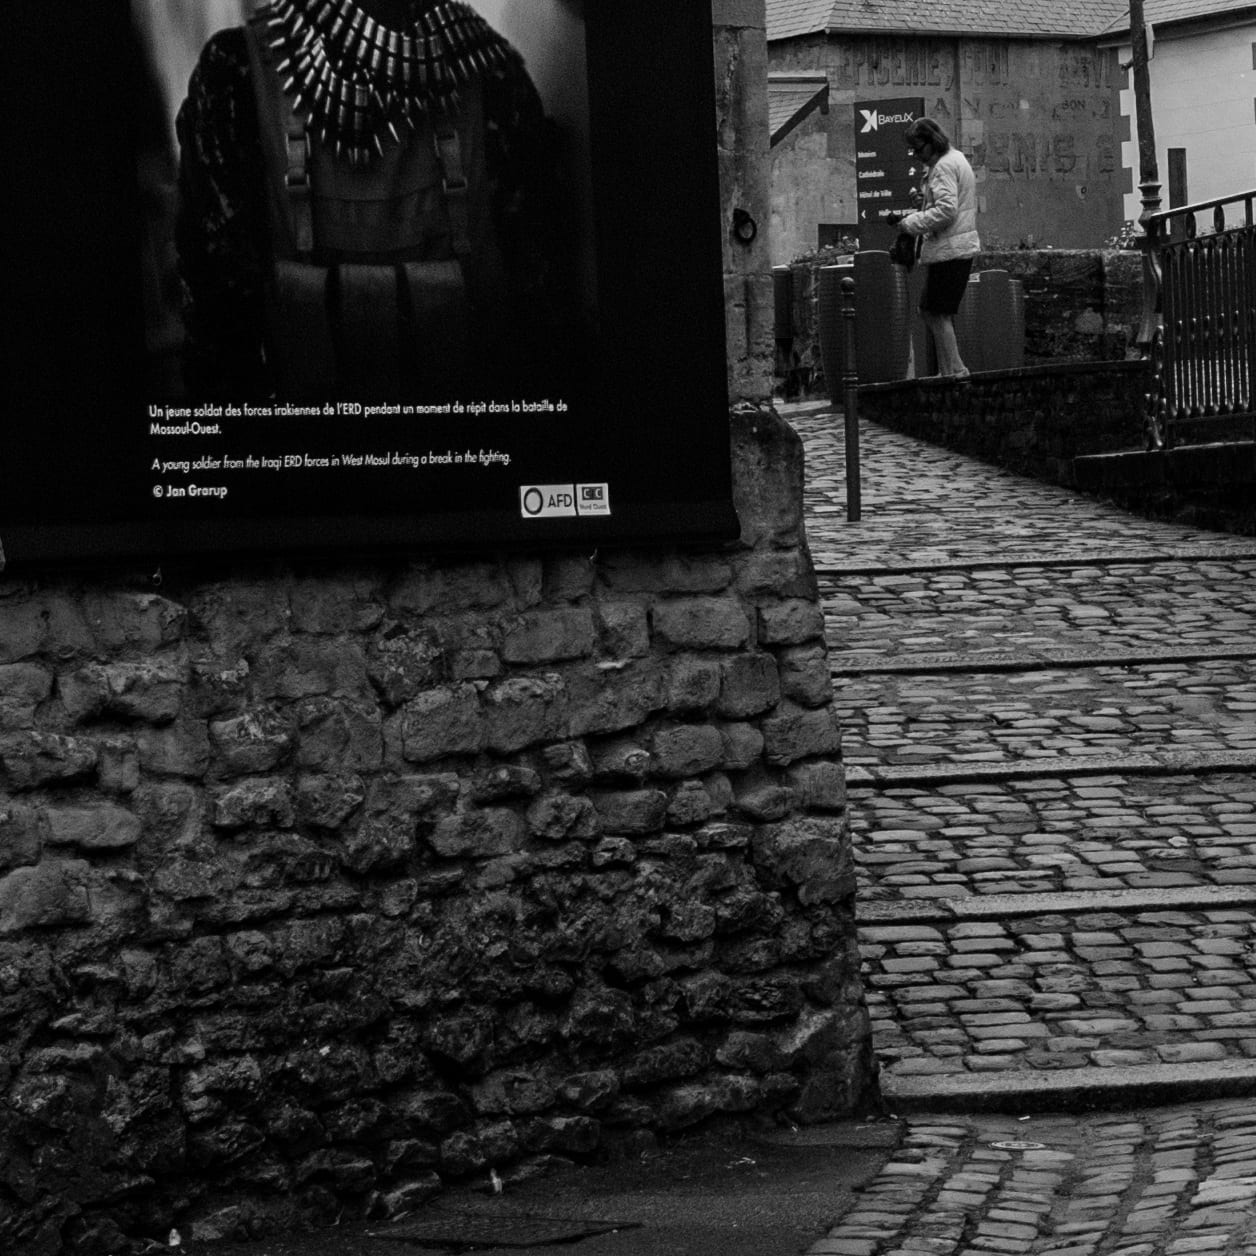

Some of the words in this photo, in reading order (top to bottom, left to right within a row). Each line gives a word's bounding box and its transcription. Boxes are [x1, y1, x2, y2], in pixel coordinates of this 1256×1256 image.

[878, 111, 914, 125] BAYEUX
[149, 404, 163, 417] Un
[166, 405, 191, 420] jeune
[194, 404, 222, 416] soldat
[225, 404, 241, 416] des
[244, 403, 272, 415] forces
[275, 404, 320, 415] irakiennes
[323, 403, 334, 415] de
[365, 403, 400, 417] pendant
[403, 406, 413, 414] un
[417, 404, 451, 414] moment
[453, 402, 464, 413] de
[467, 401, 486, 416] répit
[489, 401, 509, 412] dans
[512, 400, 519, 412] la
[522, 400, 554, 412] bataille
[557, 399, 568, 411] de
[150, 422, 222, 435] Mossoul-Ouest.
[152, 458, 160, 470] A
[162, 460, 189, 473] young
[192, 456, 221, 469] soldier
[223, 455, 243, 468] from
[246, 455, 259, 468] the
[262, 456, 282, 471] Iraqi
[285, 455, 302, 467] ERD
[304, 454, 329, 466] forces
[331, 454, 339, 466] in
[342, 454, 363, 466] West
[365, 451, 390, 465] Mosul
[392, 451, 418, 468] during
[421, 455, 426, 464] a
[429, 451, 452, 464] break
[455, 451, 462, 463] in
[465, 450, 476, 463] the
[479, 449, 511, 466] fighting.
[166, 486, 185, 497] Jan
[188, 484, 228, 498] Grarup
[548, 493, 572, 508] AFD
